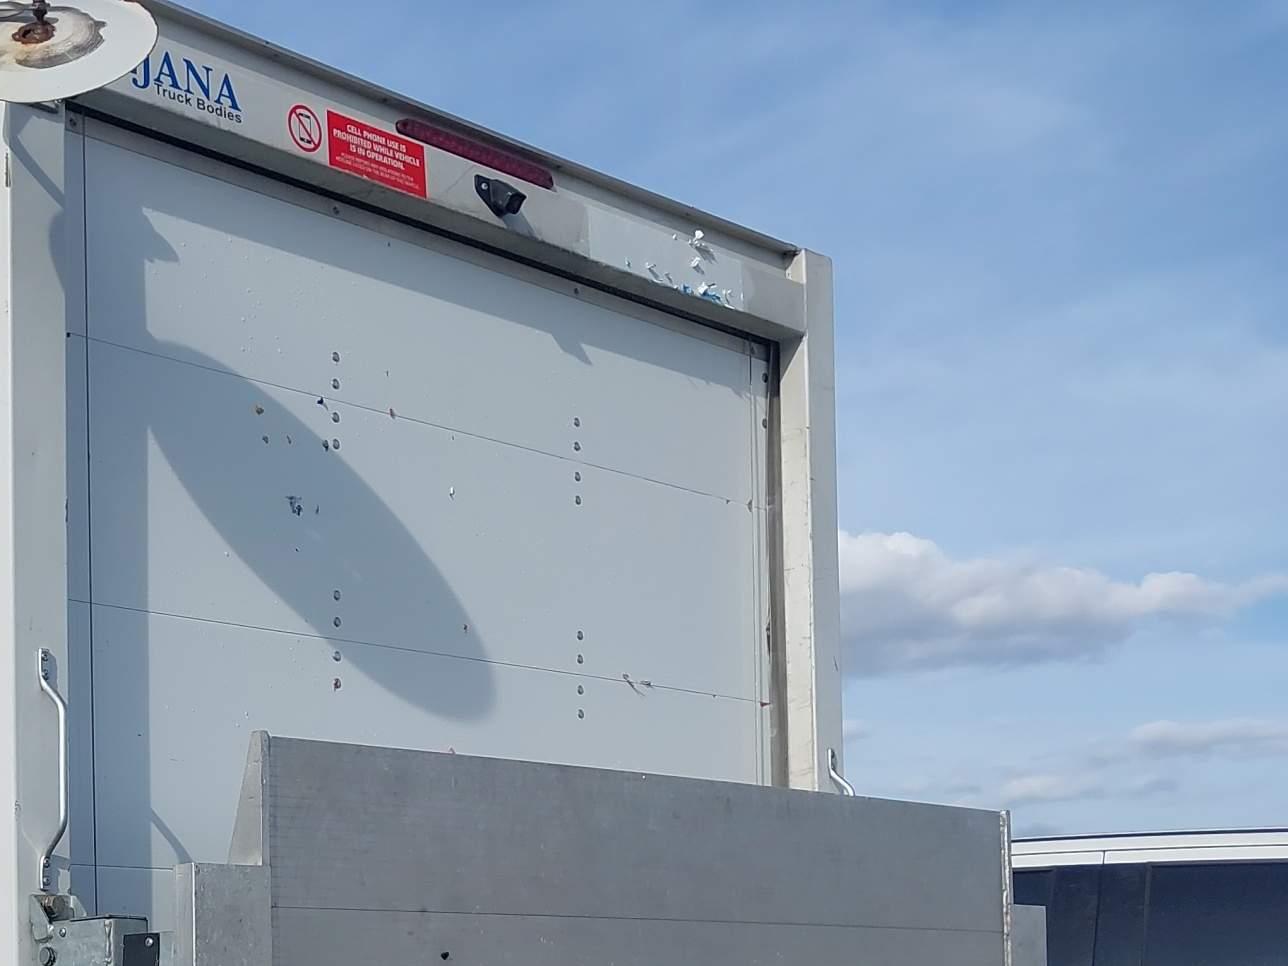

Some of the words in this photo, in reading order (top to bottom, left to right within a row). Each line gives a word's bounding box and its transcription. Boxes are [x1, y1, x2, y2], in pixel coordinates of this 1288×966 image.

[130, 51, 241, 112] JANA
[154, 82, 193, 107] Truck
[196, 98, 242, 123] Bodies
[333, 128, 372, 149] PROHIBITED
[373, 142, 395, 158] WHILE
[394, 150, 420, 167] VEHICLE
[346, 124, 362, 137] CELL
[363, 130, 386, 145] PHONE
[387, 138, 400, 149] USE
[400, 143, 407, 152] IS
[349, 144, 356, 153] IS
[357, 148, 366, 156] IN
